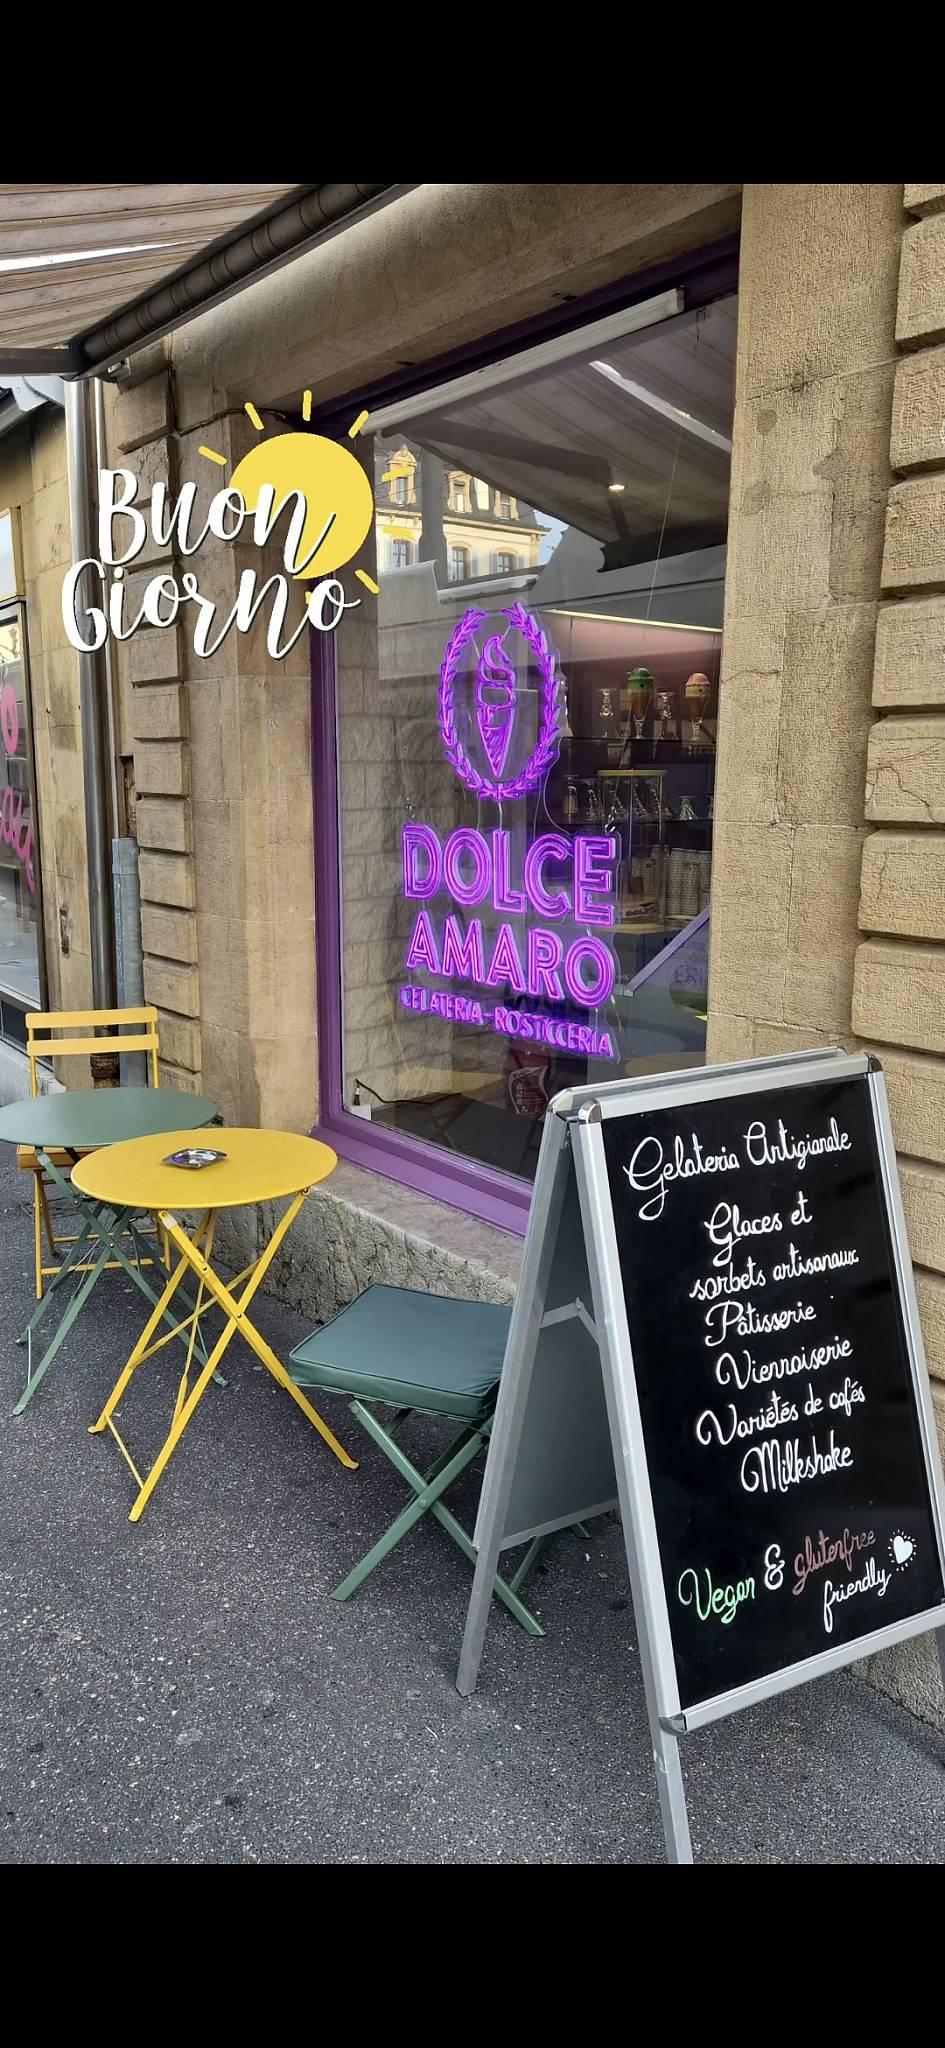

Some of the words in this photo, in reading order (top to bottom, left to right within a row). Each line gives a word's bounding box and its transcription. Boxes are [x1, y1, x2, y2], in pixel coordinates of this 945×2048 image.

[403, 823, 616, 927] DOLCE
[406, 910, 615, 1008] AMARO
[622, 1133, 740, 1220] Gelateria
[742, 1117, 852, 1170] Artigianale
[703, 1202, 783, 1266] Glaces
[791, 1190, 812, 1225] et
[689, 1256, 766, 1300] sorbets
[773, 1242, 859, 1282] artisanaux
[704, 1300, 817, 1347] Pâtisserie
[715, 1335, 854, 1390] Viennoiserie
[696, 1389, 799, 1446] Variétés
[804, 1383, 824, 1415] de
[829, 1376, 866, 1416] cafés
[740, 1429, 854, 1493] Milkshake
[678, 1568, 756, 1624] Vegan
[764, 1543, 785, 1590] &
[823, 1557, 892, 1633] friendly
